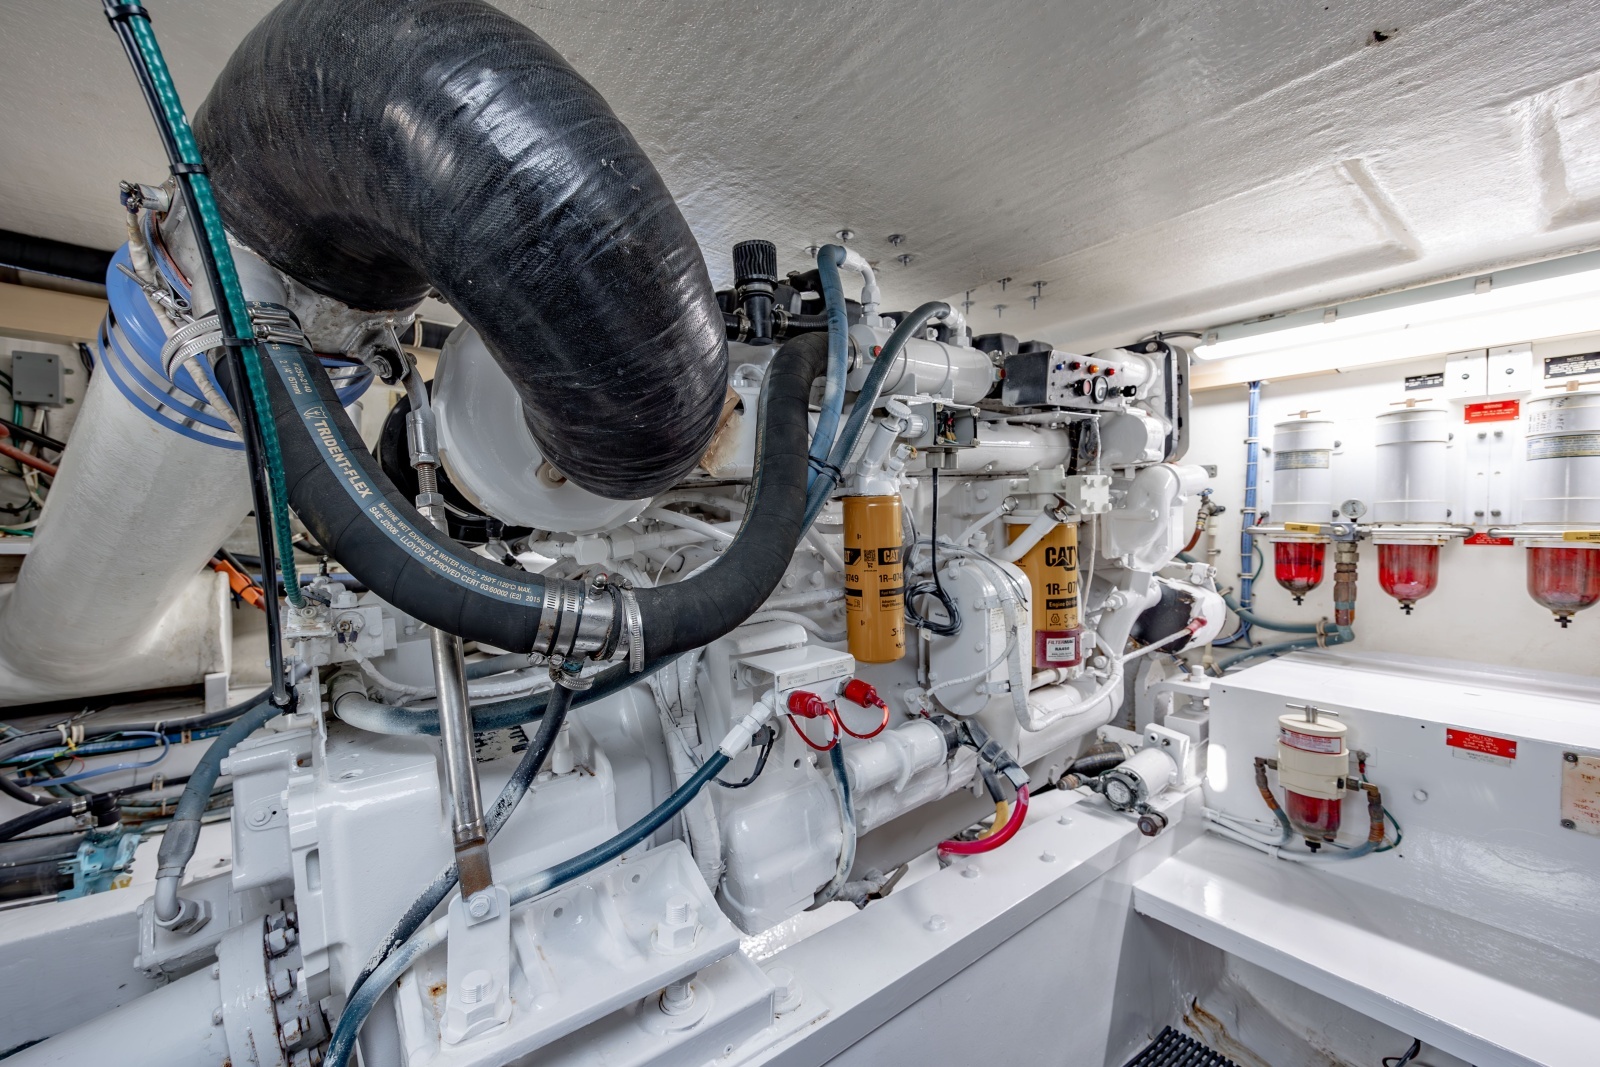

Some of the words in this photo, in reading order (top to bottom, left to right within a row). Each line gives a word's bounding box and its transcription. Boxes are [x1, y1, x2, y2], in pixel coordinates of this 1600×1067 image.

[314, 419, 373, 499] TRIDENT-FLEX
[378, 502, 400, 523] MARINE
[397, 520, 411, 533] WET
[408, 531, 435, 552] EXHAUST
[438, 552, 460, 568] WATER
[458, 564, 477, 577] HOSE
[369, 506, 383, 520] SAE
[380, 519, 399, 535] J2006
[424, 555, 461, 578] APPROVED
[460, 574, 481, 587] CERT
[509, 592, 522, 601] (E2)
[525, 595, 541, 603] 2015
[883, 549, 899, 563] CAT
[1045, 546, 1073, 567] CAT
[1048, 601, 1065, 609] Engine
[1468, 733, 1494, 742] CAUTION
